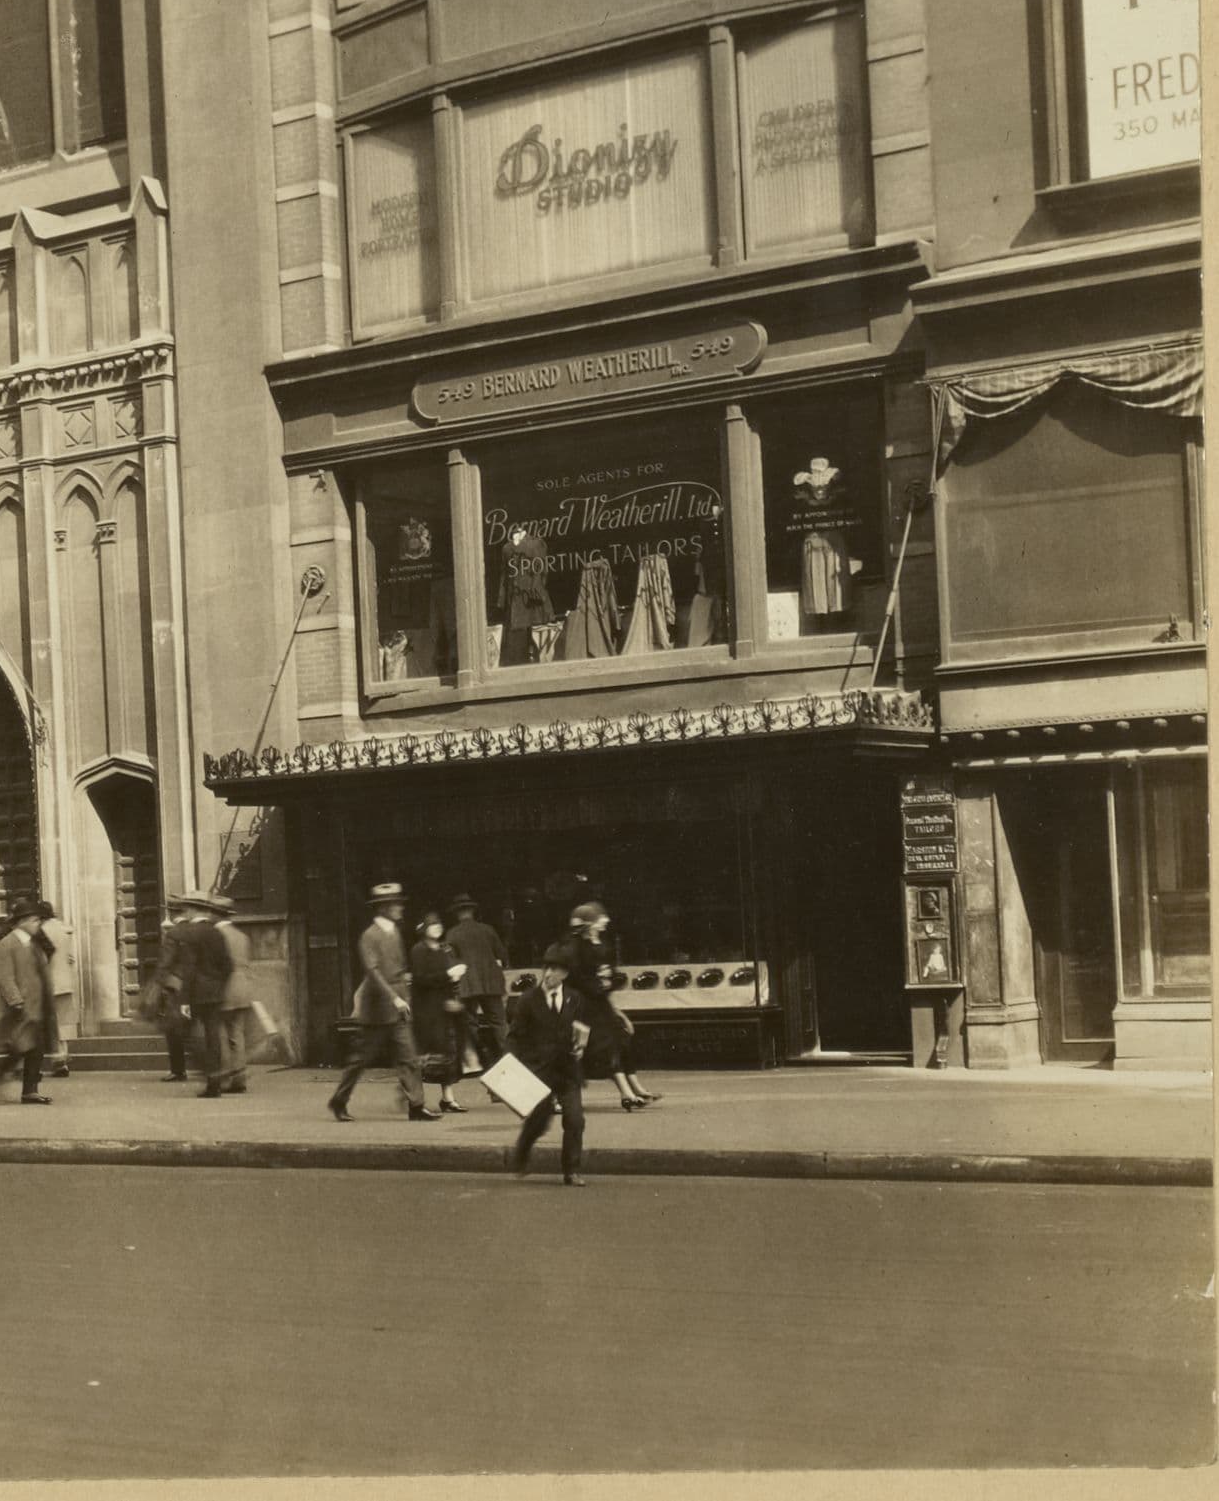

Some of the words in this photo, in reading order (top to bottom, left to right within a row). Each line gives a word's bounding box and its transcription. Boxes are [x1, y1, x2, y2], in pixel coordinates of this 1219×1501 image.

[1112, 52, 1199, 111] FRED
[1112, 114, 1159, 142] 350
[535, 171, 631, 218] STUDIO
[437, 381, 476, 404] 549
[481, 365, 561, 400] BERNARD
[567, 344, 681, 384] WEATHERILL
[690, 335, 734, 361] 549
[536, 477, 572, 492] SOLE
[577, 466, 631, 486] AGENTS
[637, 462, 665, 475] FOR
[485, 501, 576, 546] Bernard
[507, 548, 607, 578] SPORTING
[609, 534, 704, 565] TAILORS
